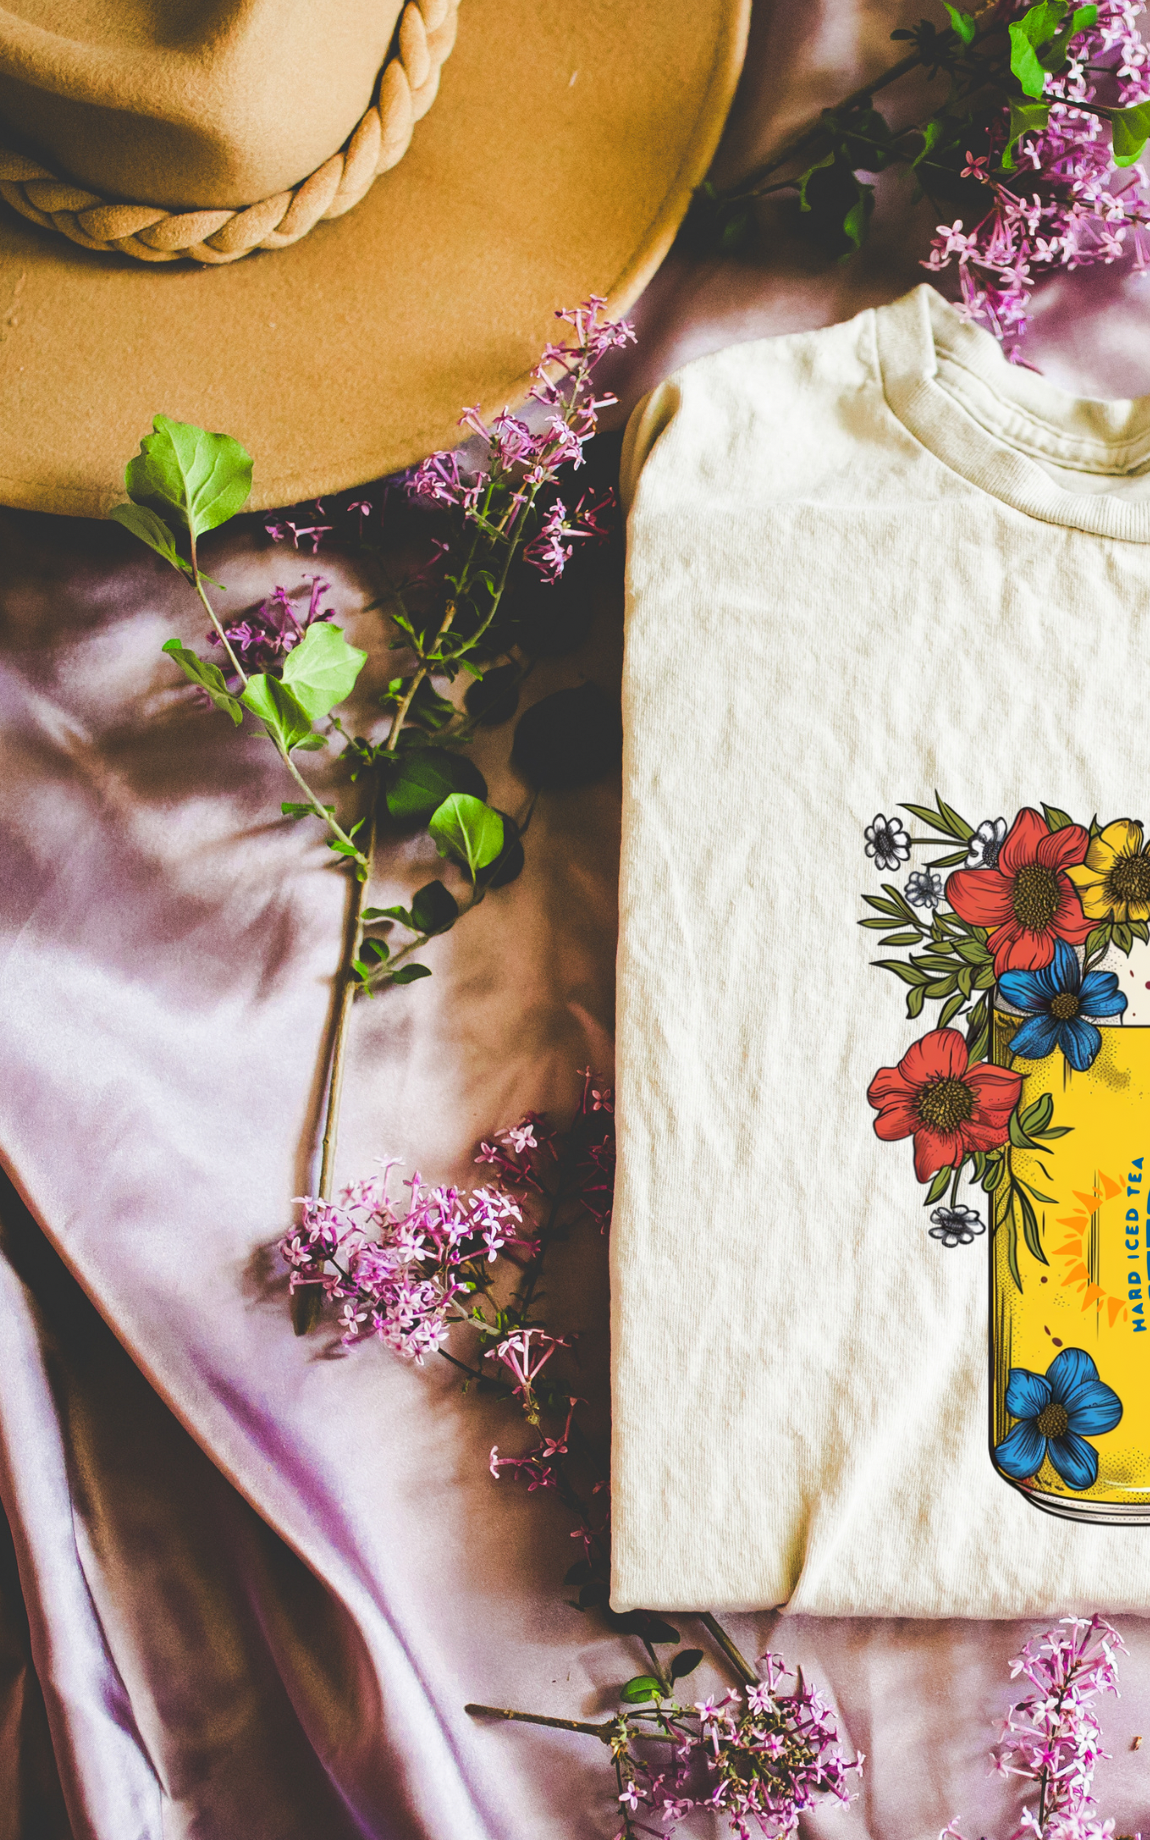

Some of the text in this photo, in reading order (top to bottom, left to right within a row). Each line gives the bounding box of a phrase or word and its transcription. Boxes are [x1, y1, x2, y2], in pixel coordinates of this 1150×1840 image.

[1125, 1157, 1147, 1333] HARD ICED TEA
